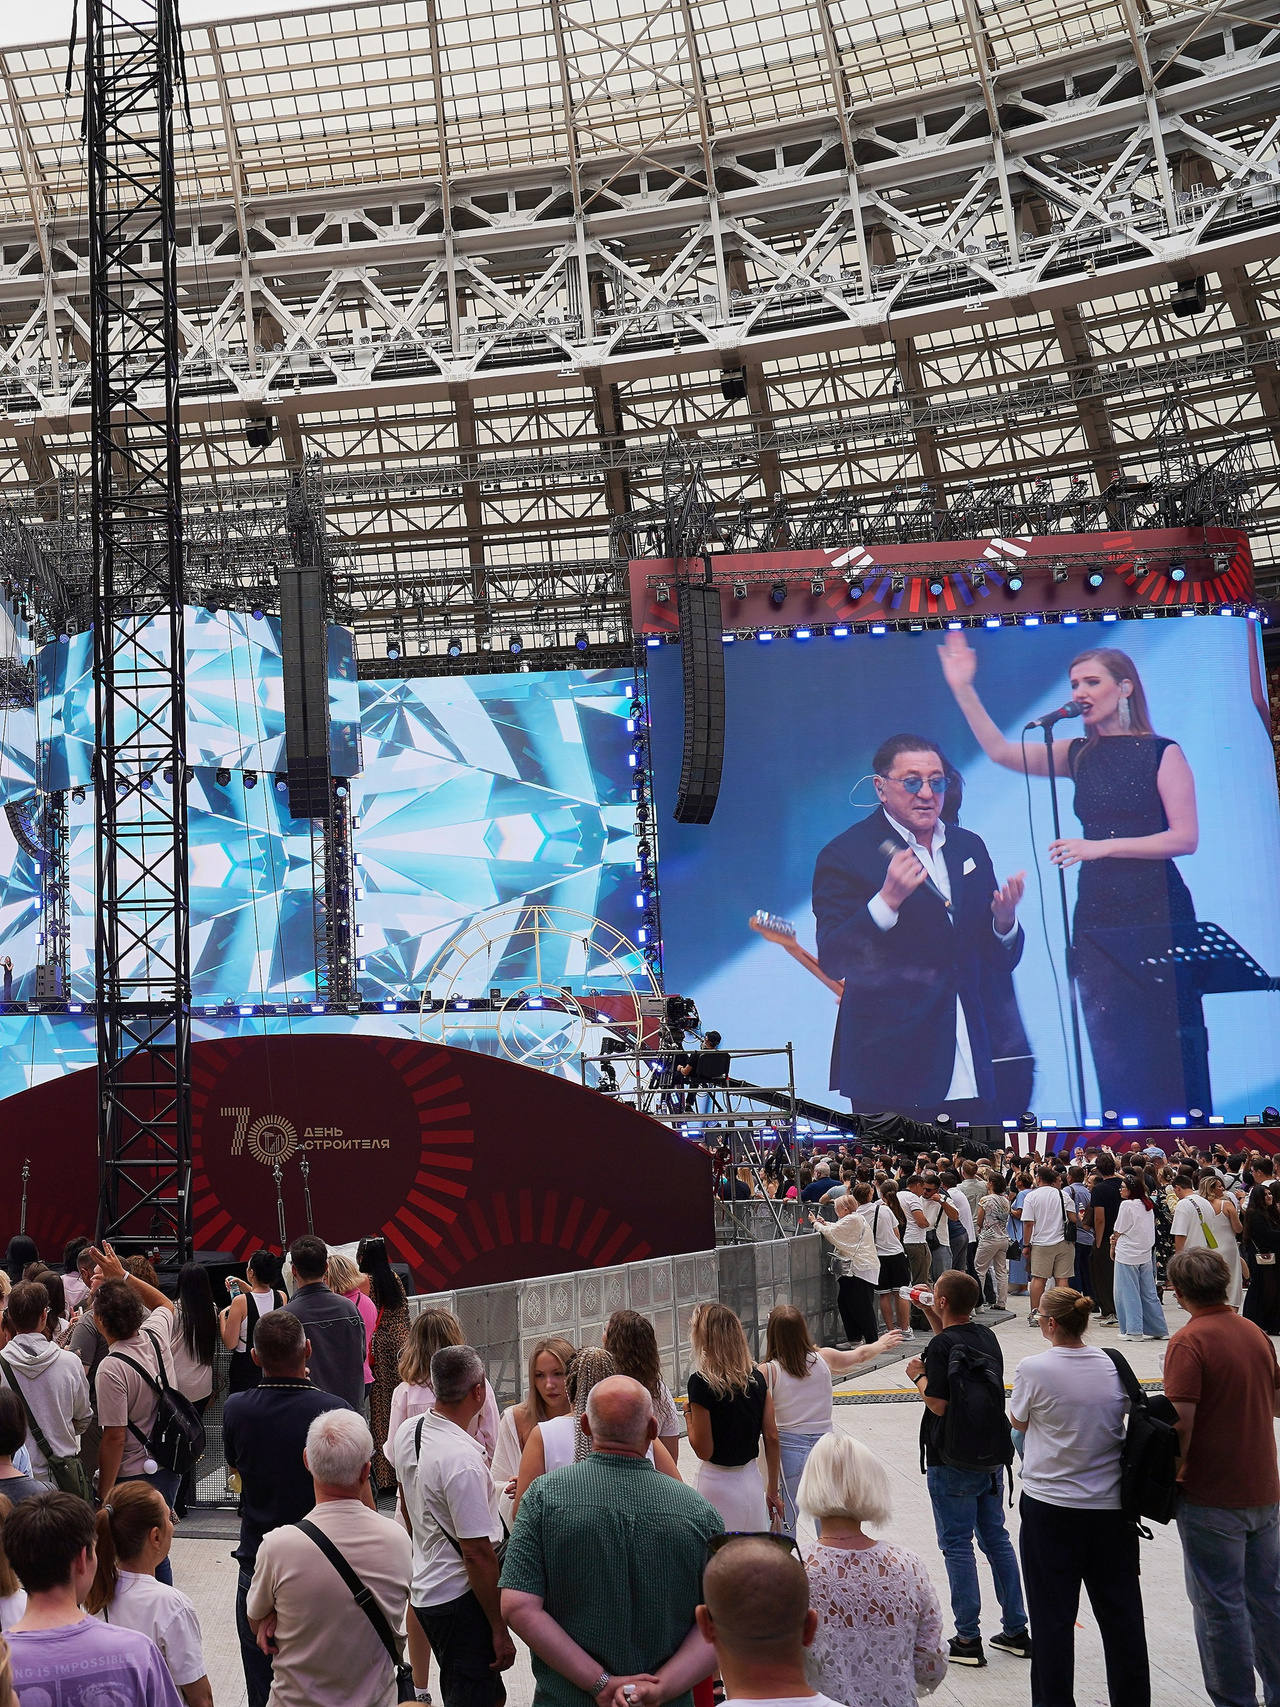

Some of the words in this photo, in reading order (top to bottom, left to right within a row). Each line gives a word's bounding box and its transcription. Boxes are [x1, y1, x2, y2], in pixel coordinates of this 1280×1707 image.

[220, 1106, 298, 1166] 70
[303, 1126, 344, 1137] ДЕНЬ
[304, 1138, 391, 1150] СТРОИТЕЛЯ
[38, 1666, 51, 1677] IS
[55, 1652, 135, 1675] IMPOSSIBLE
